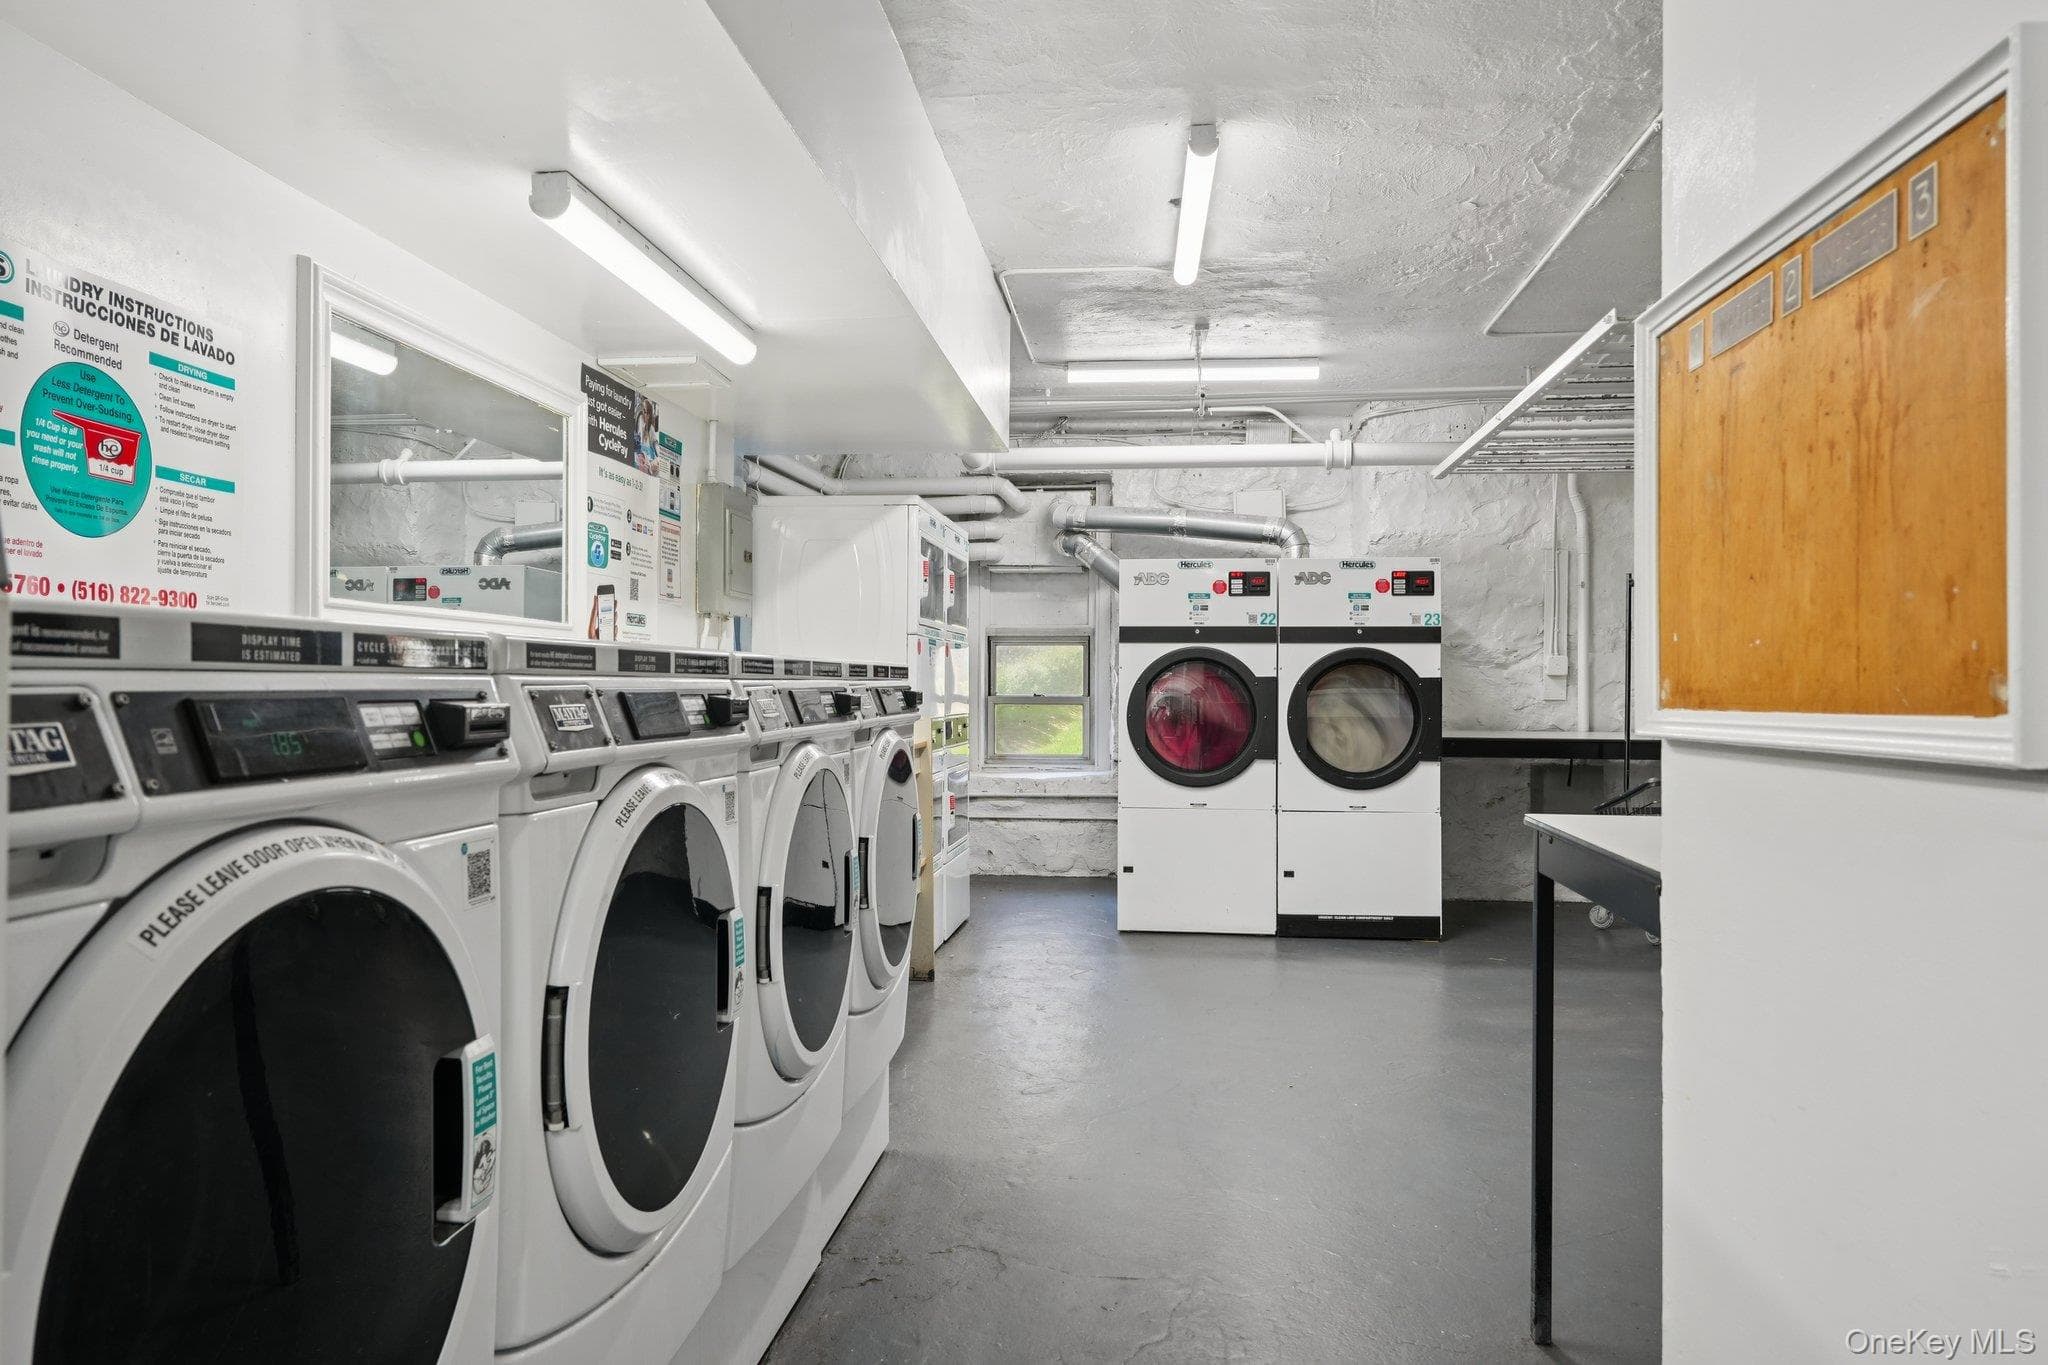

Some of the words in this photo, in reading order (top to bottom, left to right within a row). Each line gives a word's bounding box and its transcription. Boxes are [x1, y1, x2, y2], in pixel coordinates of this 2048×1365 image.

[1915, 180, 1931, 220] 3
[1786, 269, 1797, 302] 2
[26, 278, 156, 338] INSTRUCCIONES
[161, 328, 180, 346] DE
[184, 336, 235, 365] LAVADO
[109, 291, 214, 342] INSTRUCTIONS
[74, 328, 119, 354] Detergent
[54, 338, 122, 370] Recommended
[80, 370, 96, 382] Use
[178, 364, 207, 380] DRYING
[52, 376, 70, 389] Less
[73, 382, 113, 401] Detergent
[115, 394, 125, 405] To
[586, 374, 605, 396] Paying
[42, 388, 74, 405] Prevent
[596, 401, 608, 412] got
[35, 418, 45, 427] 1/4
[599, 416, 627, 440] Hercules
[27, 429, 40, 438] you
[598, 433, 628, 458] CyclePay
[65, 451, 77, 460] not
[111, 467, 123, 475] cup
[179, 473, 207, 486] SECAR
[1180, 560, 1212, 568] Hercules
[1134, 572, 1170, 585] ADC
[1294, 572, 1331, 585] ADC
[72, 580, 114, 602] (516)
[120, 586, 197, 608] 822-9300
[1260, 613, 1276, 625] 22
[1424, 614, 1440, 625] 23
[242, 634, 278, 647] DISPLAY
[280, 635, 301, 647] TIME
[357, 640, 384, 653] CYCLE
[242, 649, 251, 660] IS
[254, 650, 300, 662] ESTIMATED
[552, 706, 588, 721] MAYTAG
[615, 798, 638, 828] PLEASE
[634, 784, 652, 802] LEAVE
[139, 889, 204, 947] PLEASE
[200, 859, 249, 897] LEAVE
[243, 843, 288, 869] DOOR
[284, 835, 323, 853] OPEN
